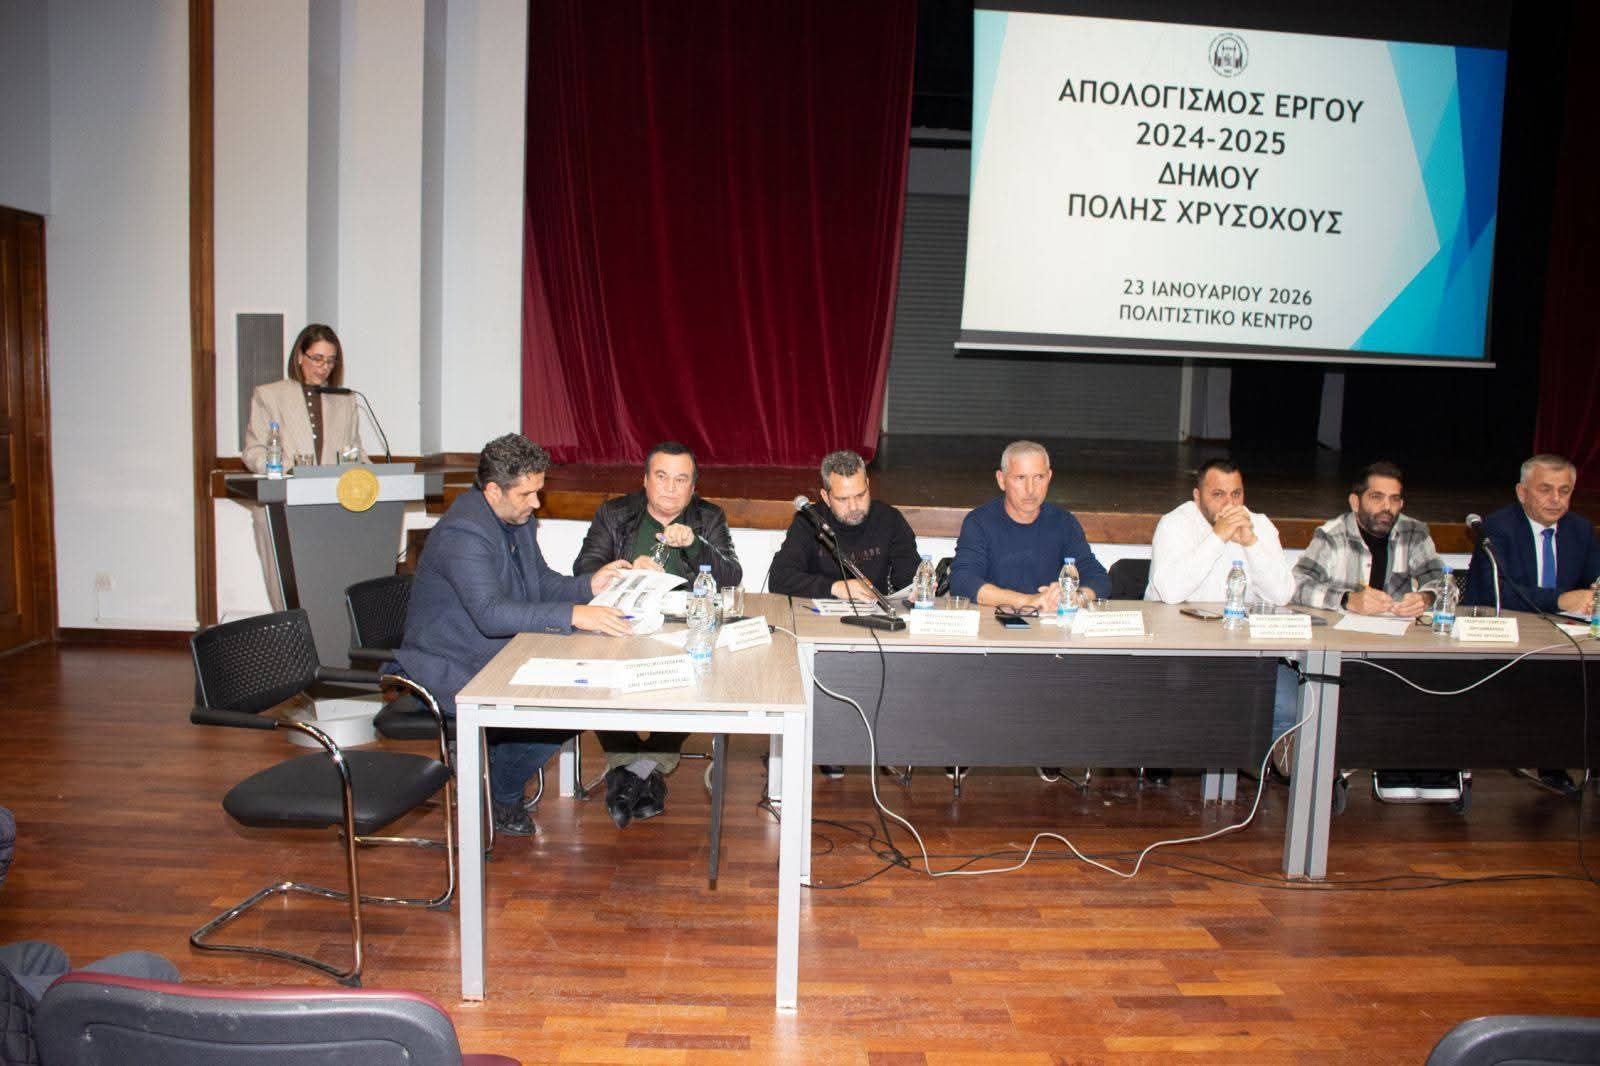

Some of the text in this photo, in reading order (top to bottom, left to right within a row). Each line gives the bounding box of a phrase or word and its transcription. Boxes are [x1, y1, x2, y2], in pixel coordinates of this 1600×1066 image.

[1058, 78, 1364, 124] ΑΠΟΛΟΓΙΣΜΟΣ ΕΡΓΟΥ
[1136, 121, 1286, 156] 2024-2025
[1158, 161, 1260, 191] ΔΗΜΟΥ
[1067, 193, 1344, 235] ΠΟΛΗΣ ΧΡΥΣΟΧΟΥΣ
[1123, 279, 1313, 306] 23 ΙΑΝΟΥΑΡΙΟΥ 2026
[1119, 303, 1313, 332] ΠΟΛΙΤΙΣΤΙΚΟ ΚΕΝΤΡΟ
